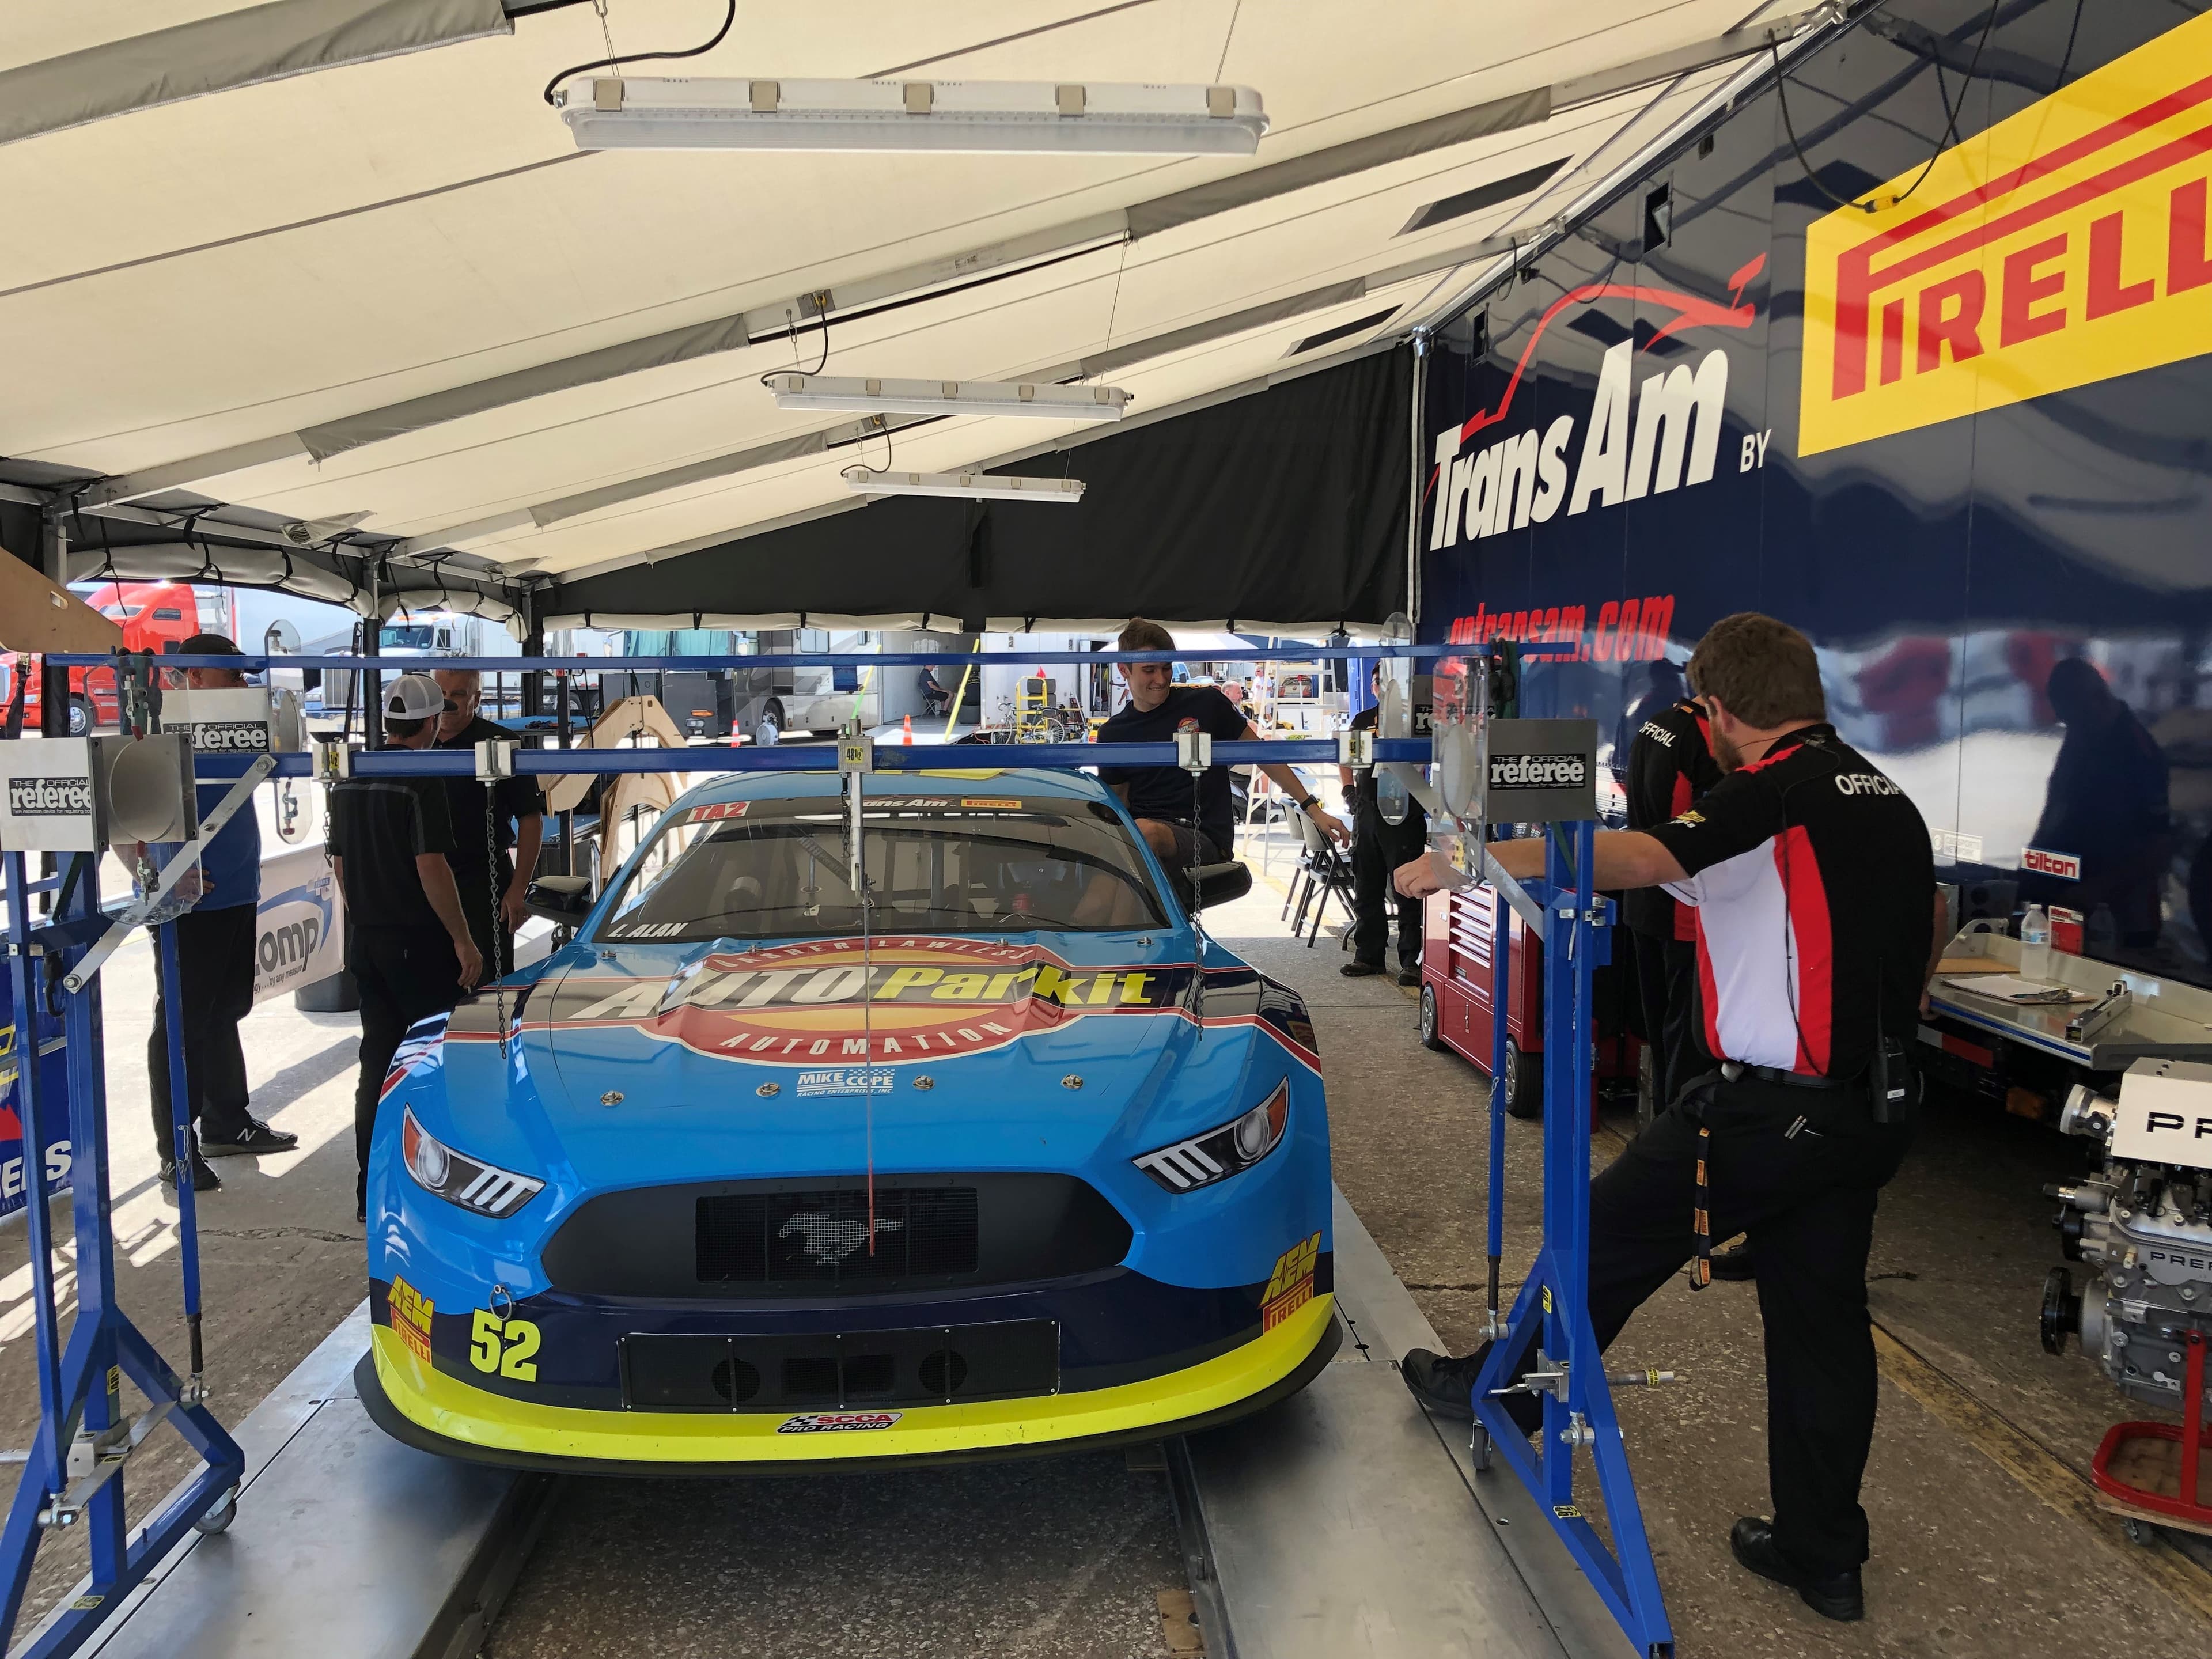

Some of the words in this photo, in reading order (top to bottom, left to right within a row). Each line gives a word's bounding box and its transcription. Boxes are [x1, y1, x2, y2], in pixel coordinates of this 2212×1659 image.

[1739, 429, 1772, 474] BY
[1491, 755, 1584, 783] referee
[692, 802, 747, 820] TA2
[2024, 850, 2076, 877] tilton
[607, 923, 628, 937] L.
[626, 922, 689, 937] ALAN
[878, 940, 1033, 959] LAWLESS
[719, 1022, 1012, 1055] AUTOMATION
[797, 1072, 844, 1085] MIKE
[846, 1076, 893, 1086] COPE
[1259, 1230, 1321, 1308] AEM
[388, 1274, 434, 1336] AEM
[1264, 1275, 1313, 1333] PIRELLI
[469, 1308, 537, 1382] 52
[816, 1414, 892, 1424] SCCA
